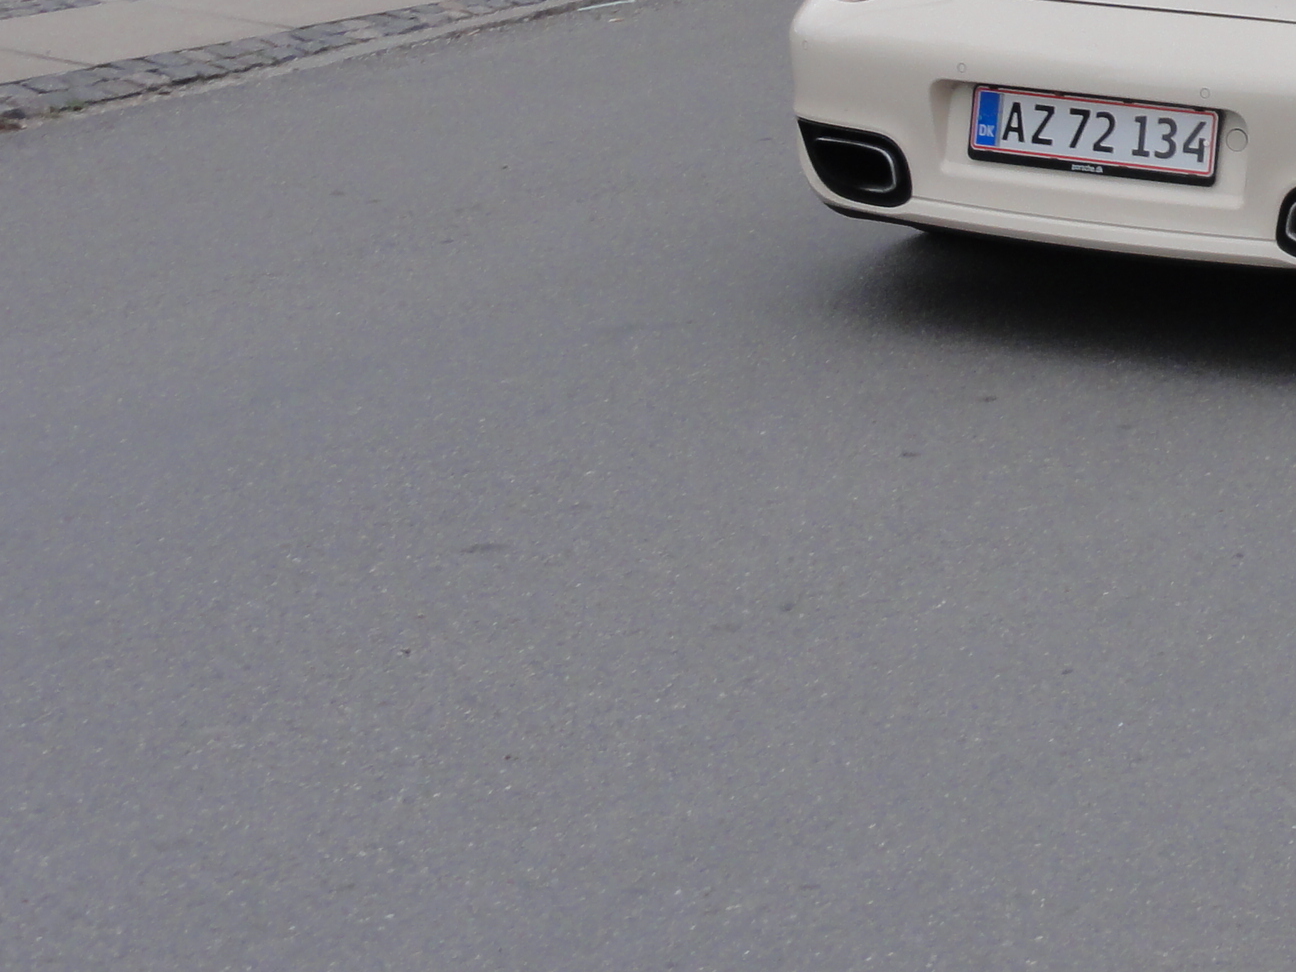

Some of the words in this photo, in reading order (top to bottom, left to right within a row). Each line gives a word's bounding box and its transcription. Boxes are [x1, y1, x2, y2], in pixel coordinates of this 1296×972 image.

[979, 124, 995, 138] DK
[1002, 101, 1055, 146] AZ
[1069, 108, 1116, 154] 72
[1132, 115, 1207, 163] 134
